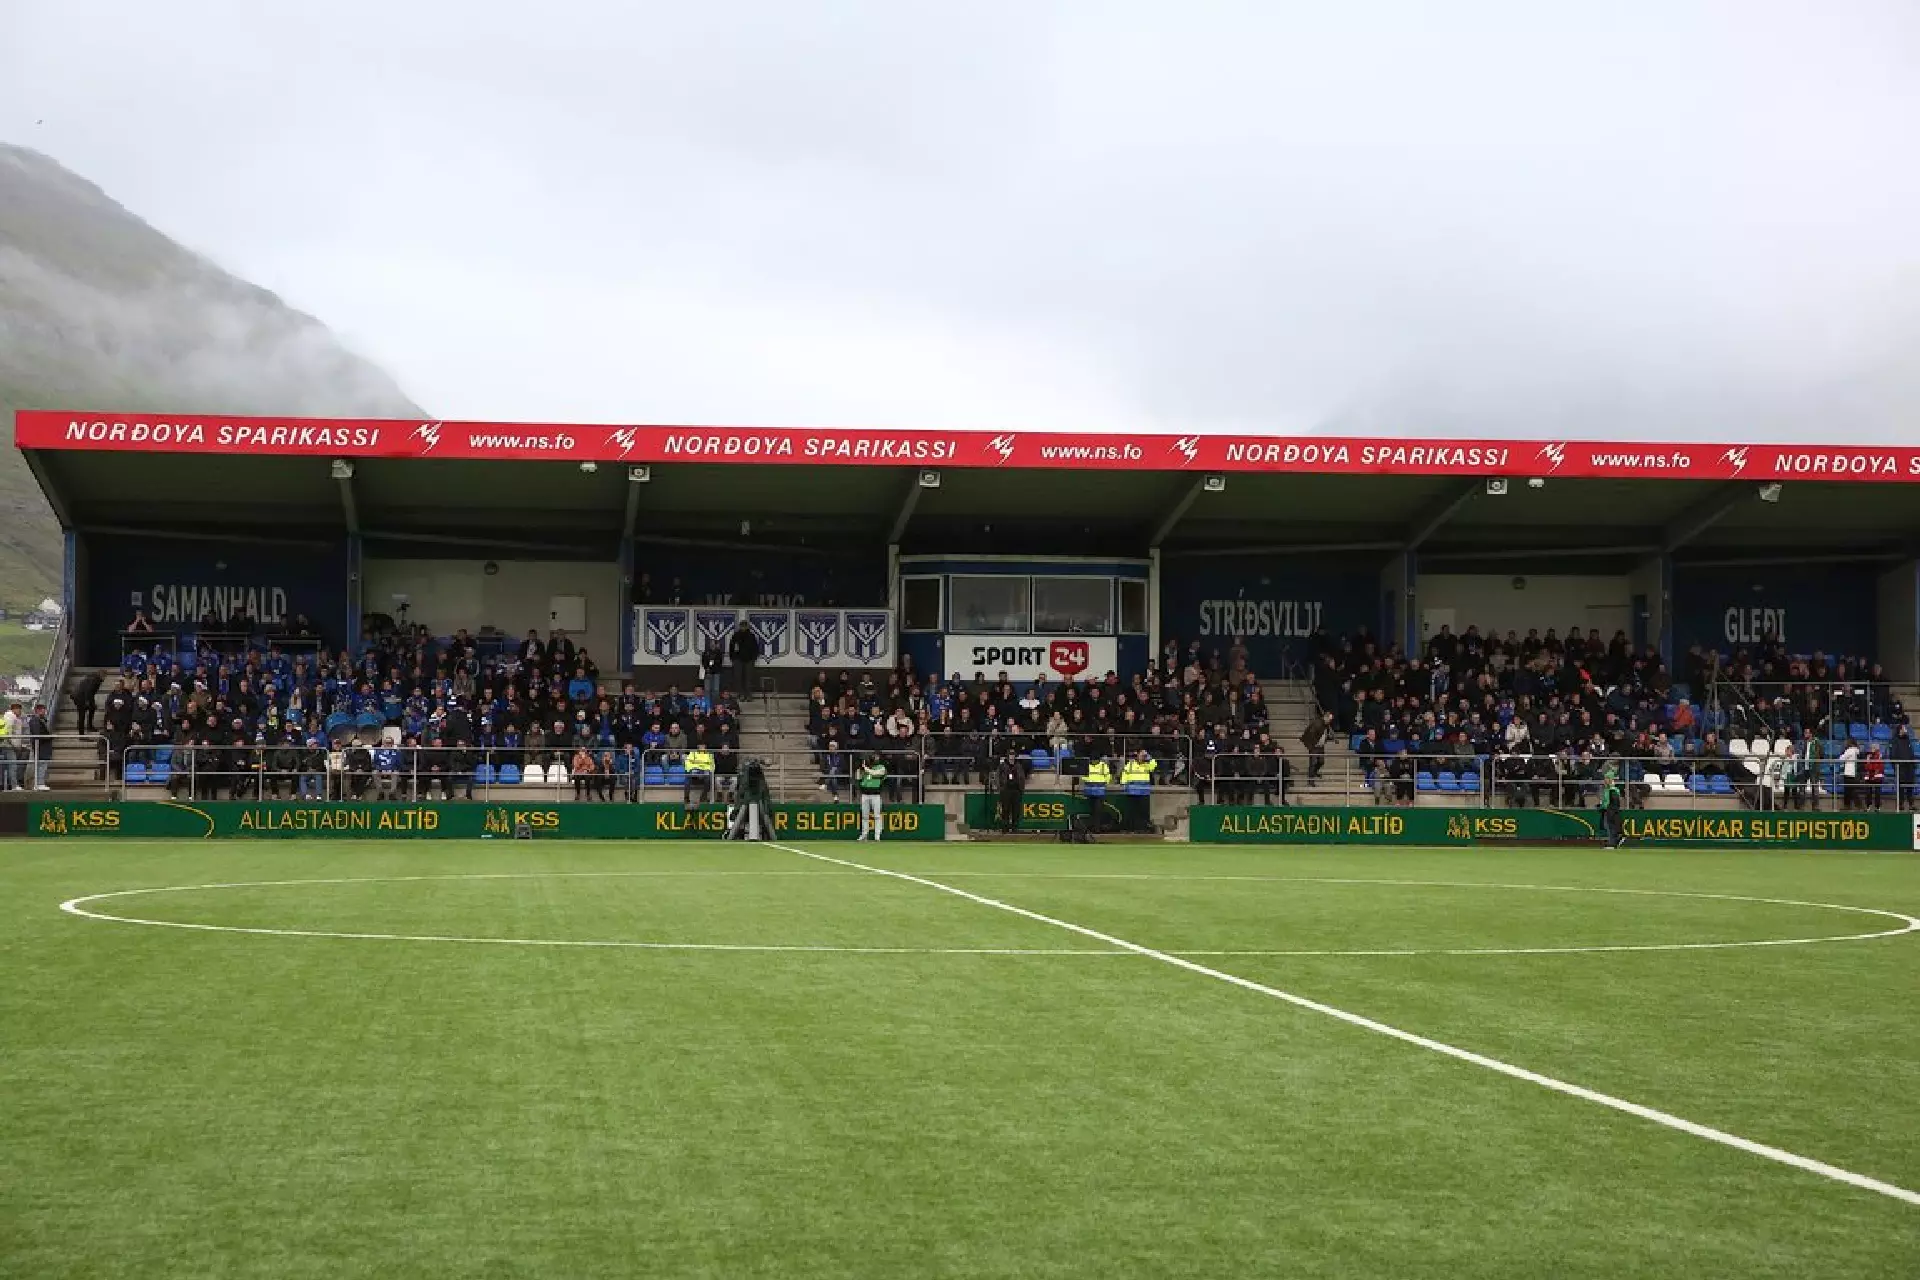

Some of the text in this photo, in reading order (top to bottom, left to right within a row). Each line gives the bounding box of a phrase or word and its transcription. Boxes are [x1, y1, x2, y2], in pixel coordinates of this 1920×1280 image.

[67, 422, 379, 445] NORÐOYA SPARIKASSI
[471, 434, 574, 449] www.ns.fo
[665, 436, 955, 457] NORÐOYA SPARIKASSI
[1042, 444, 1142, 459] www.ns.fo
[1227, 444, 1507, 465] NORÐOYA SPARIKASSI
[1592, 452, 1690, 467] www.ns.fo
[1775, 455, 1897, 472] NORÐOYA
[151, 584, 287, 623] SAMANHALD
[972, 647, 1085, 666] SPORT 24
[74, 811, 119, 825] KSS
[515, 812, 559, 825] KSS
[1024, 804, 1064, 817] KSS
[242, 810, 369, 829] ALLASTAÐNI
[1220, 815, 1339, 832] ALLASTAÐNI
[1475, 819, 1516, 832] KSS
[1752, 820, 1869, 840] SLEIPISTØÐ
